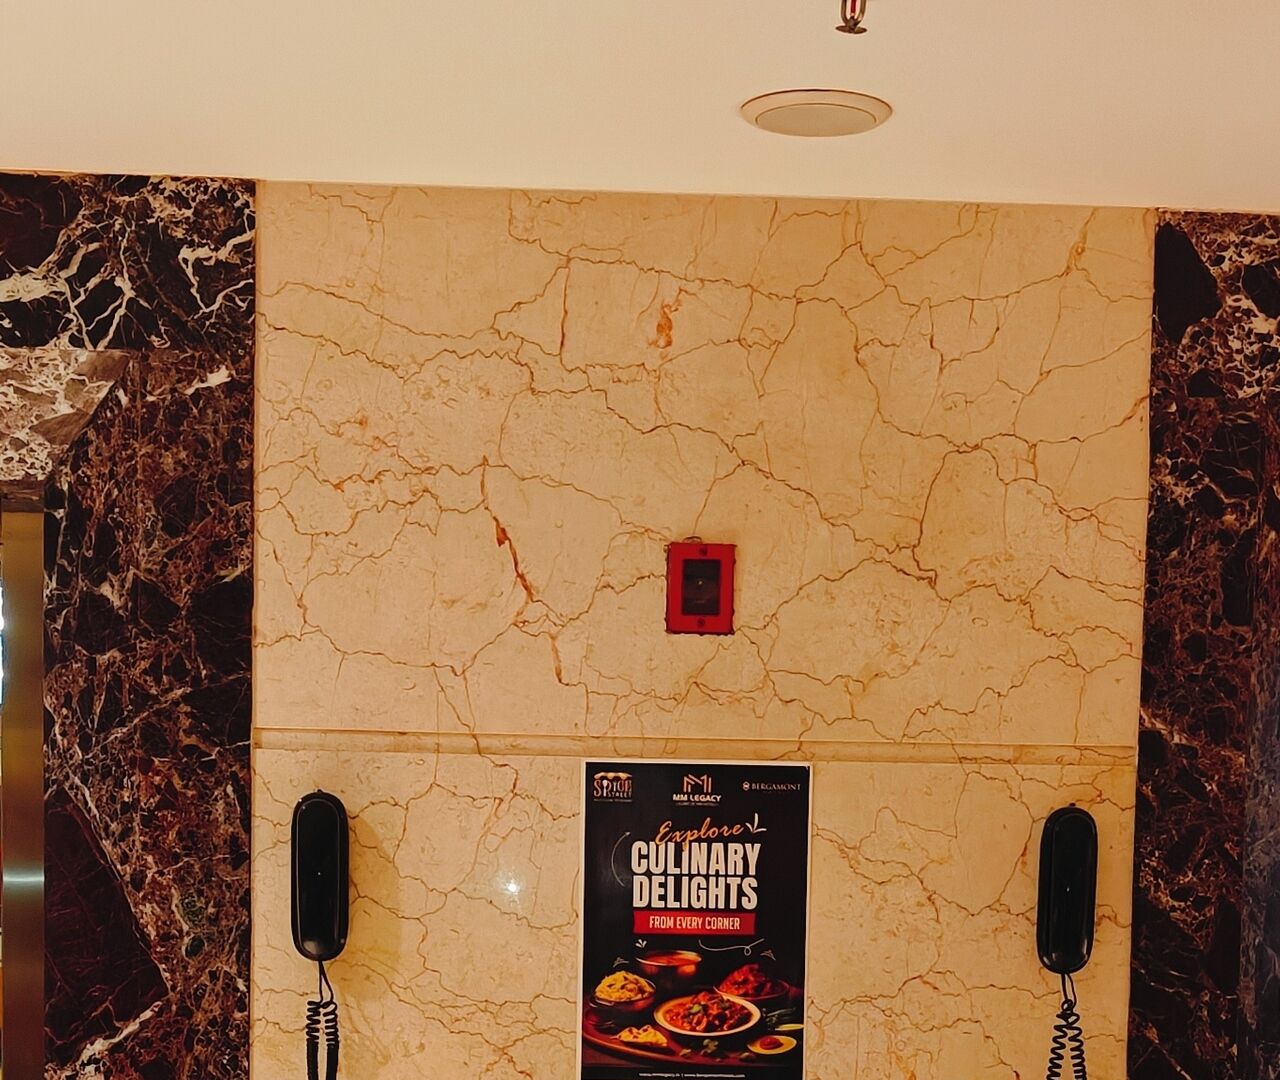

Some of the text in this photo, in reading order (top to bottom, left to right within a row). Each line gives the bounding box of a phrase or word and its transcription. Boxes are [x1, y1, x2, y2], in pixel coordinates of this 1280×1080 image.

[593, 779, 632, 798] SPICE
[751, 783, 801, 791] BERGAMONT
[690, 794, 722, 802] LEGACY
[655, 820, 745, 849] Explore
[630, 842, 762, 875] CULINARY
[632, 876, 758, 910] DELIGHTS
[649, 916, 740, 930] FROM EVERY CORNER
